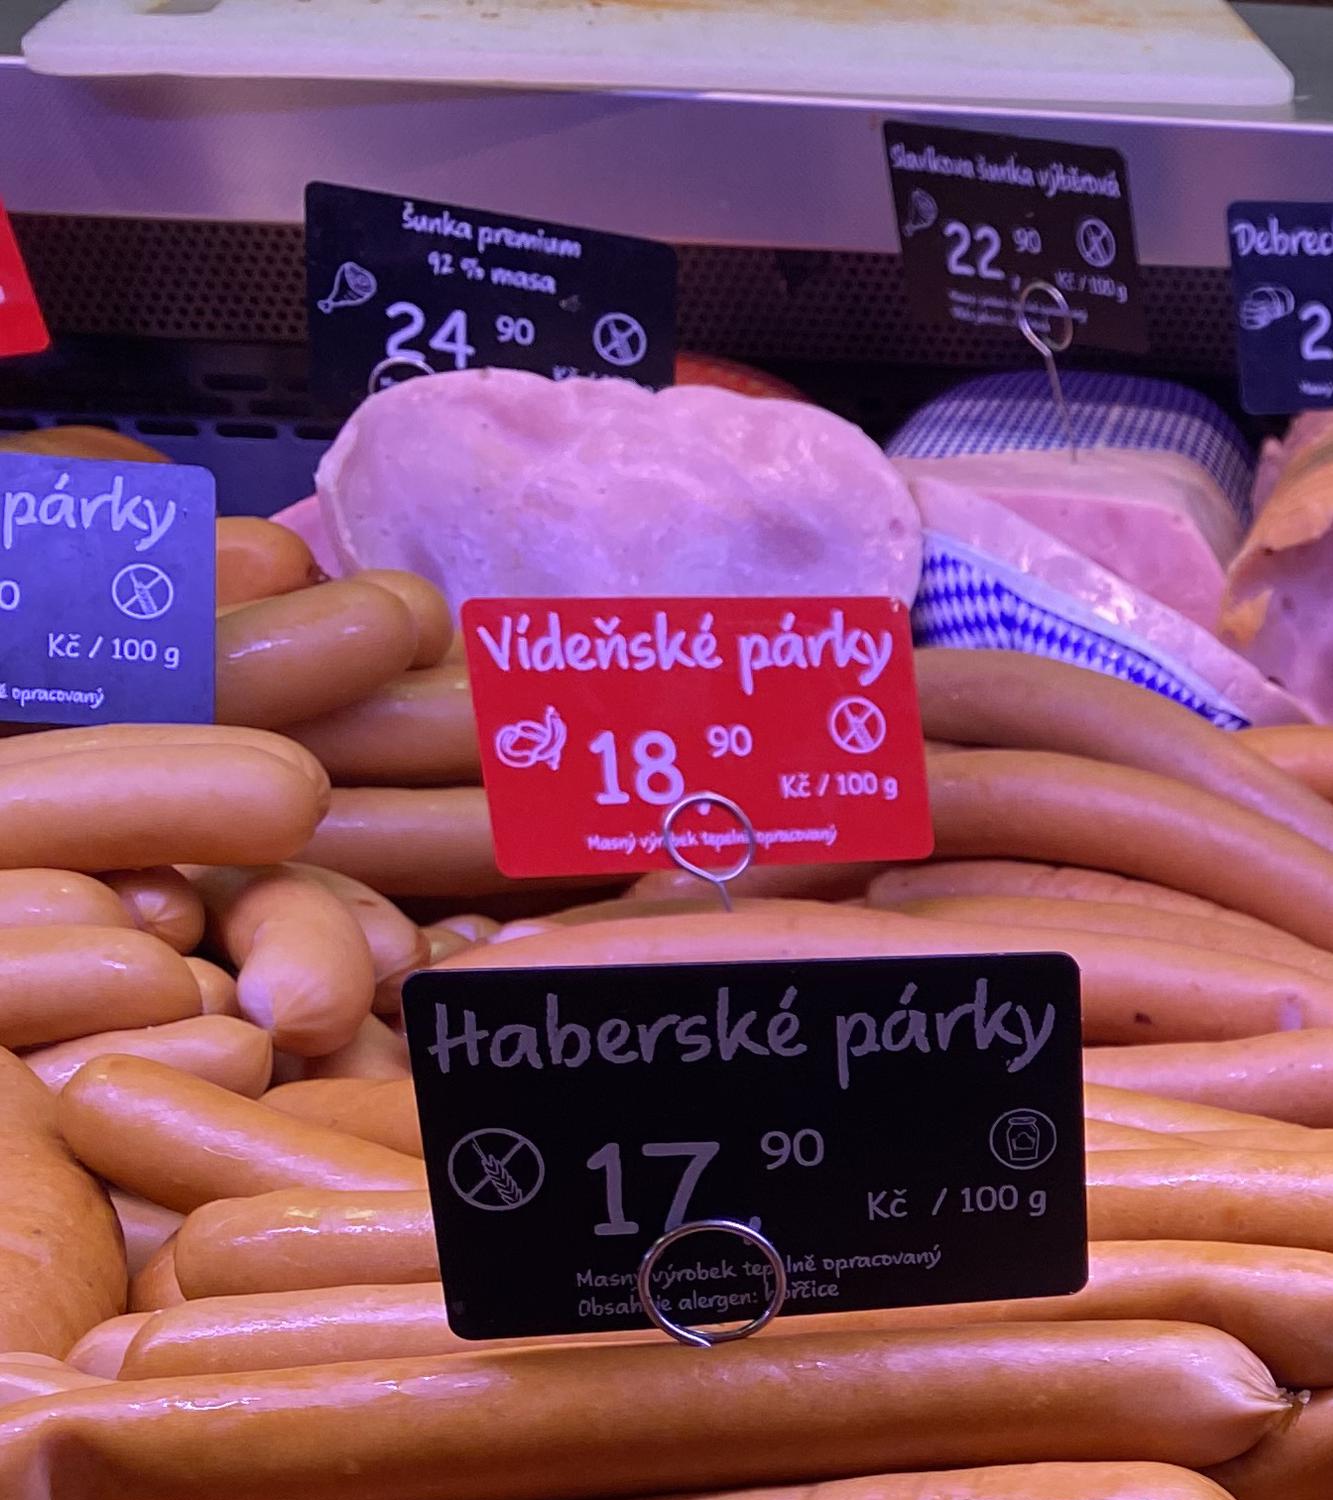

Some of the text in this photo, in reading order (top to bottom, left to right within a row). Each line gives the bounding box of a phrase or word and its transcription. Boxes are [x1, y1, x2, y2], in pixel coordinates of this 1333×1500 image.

[478, 228, 582, 259] premium
[1012, 226, 1042, 253] 90
[428, 251, 556, 295] 92 % masa
[385, 301, 535, 370] 24 90
[4, 472, 176, 551] párky
[49, 633, 81, 658] Kč
[112, 638, 156, 661] 100
[164, 646, 179, 668] g
[477, 608, 893, 696] Vídeňské párky
[12, 688, 104, 709] opracovaný
[707, 724, 753, 758] 90
[780, 773, 810, 798] Kč
[836, 772, 879, 797] 100
[884, 776, 898, 800] g
[428, 978, 1056, 1090] Haberské párky
[759, 1127, 825, 1171] 90
[867, 1187, 909, 1220] Kč
[960, 1184, 1020, 1213] 100
[1028, 1188, 1048, 1216] g
[652, 1260, 738, 1289] výrobek
[742, 1254, 817, 1283] teplně
[823, 1244, 942, 1278] opracovaný
